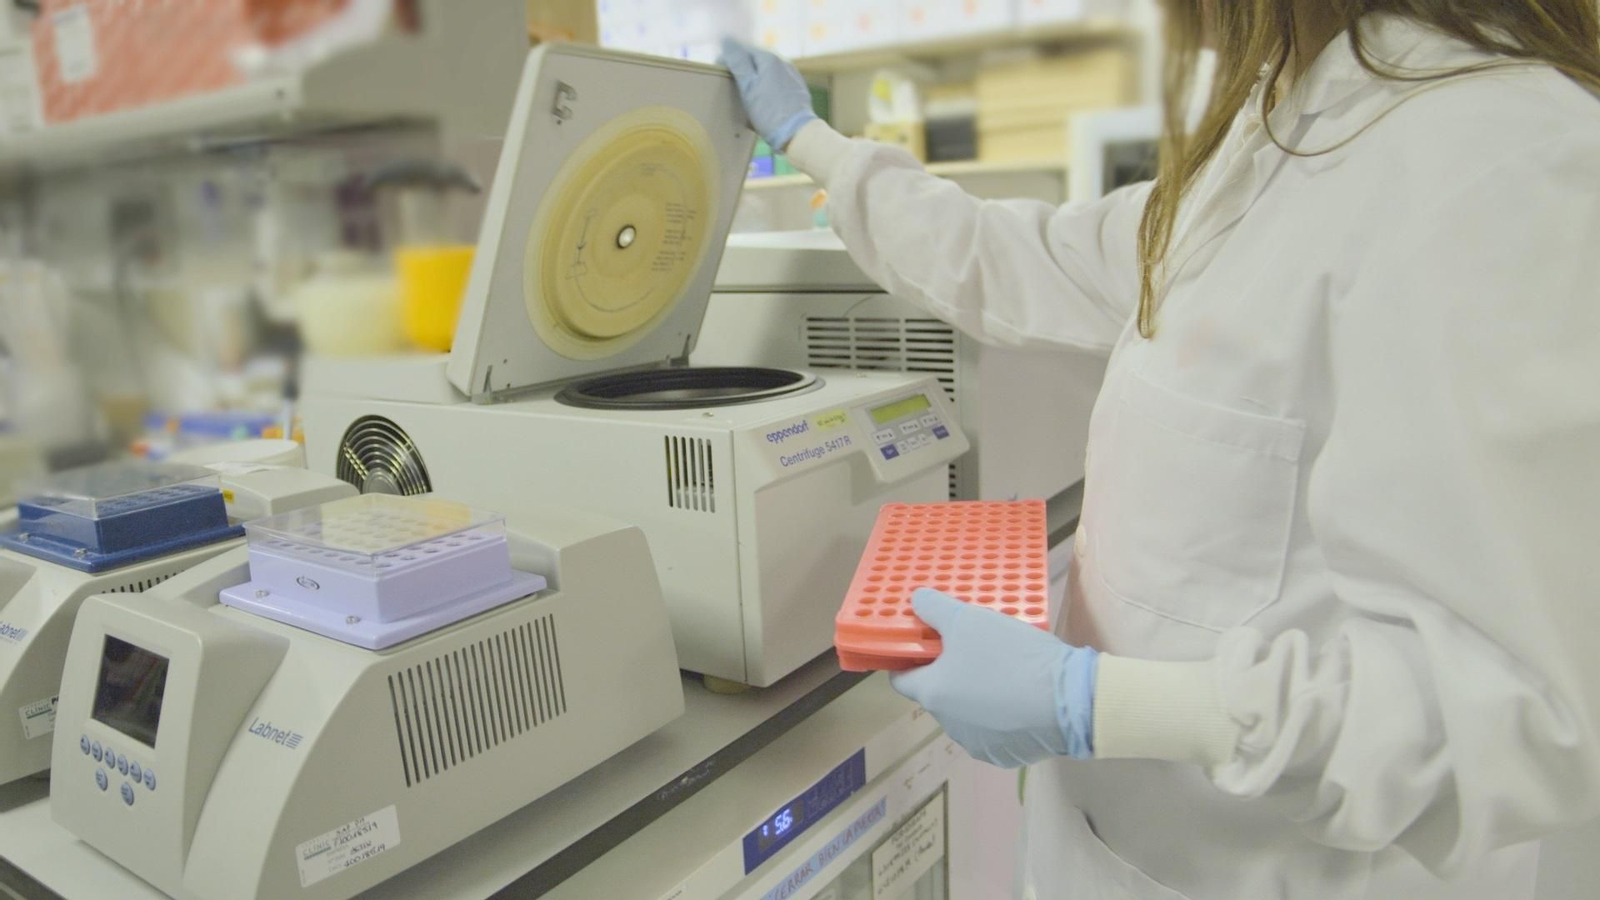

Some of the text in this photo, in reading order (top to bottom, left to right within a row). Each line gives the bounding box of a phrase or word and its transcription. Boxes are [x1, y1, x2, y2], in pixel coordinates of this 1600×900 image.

[766, 420, 810, 444] eppendorf
[779, 447, 826, 467] Centrifuge
[0, 621, 20, 639] abnet
[248, 716, 292, 746] Labnet
[817, 838, 841, 867] BIEN
